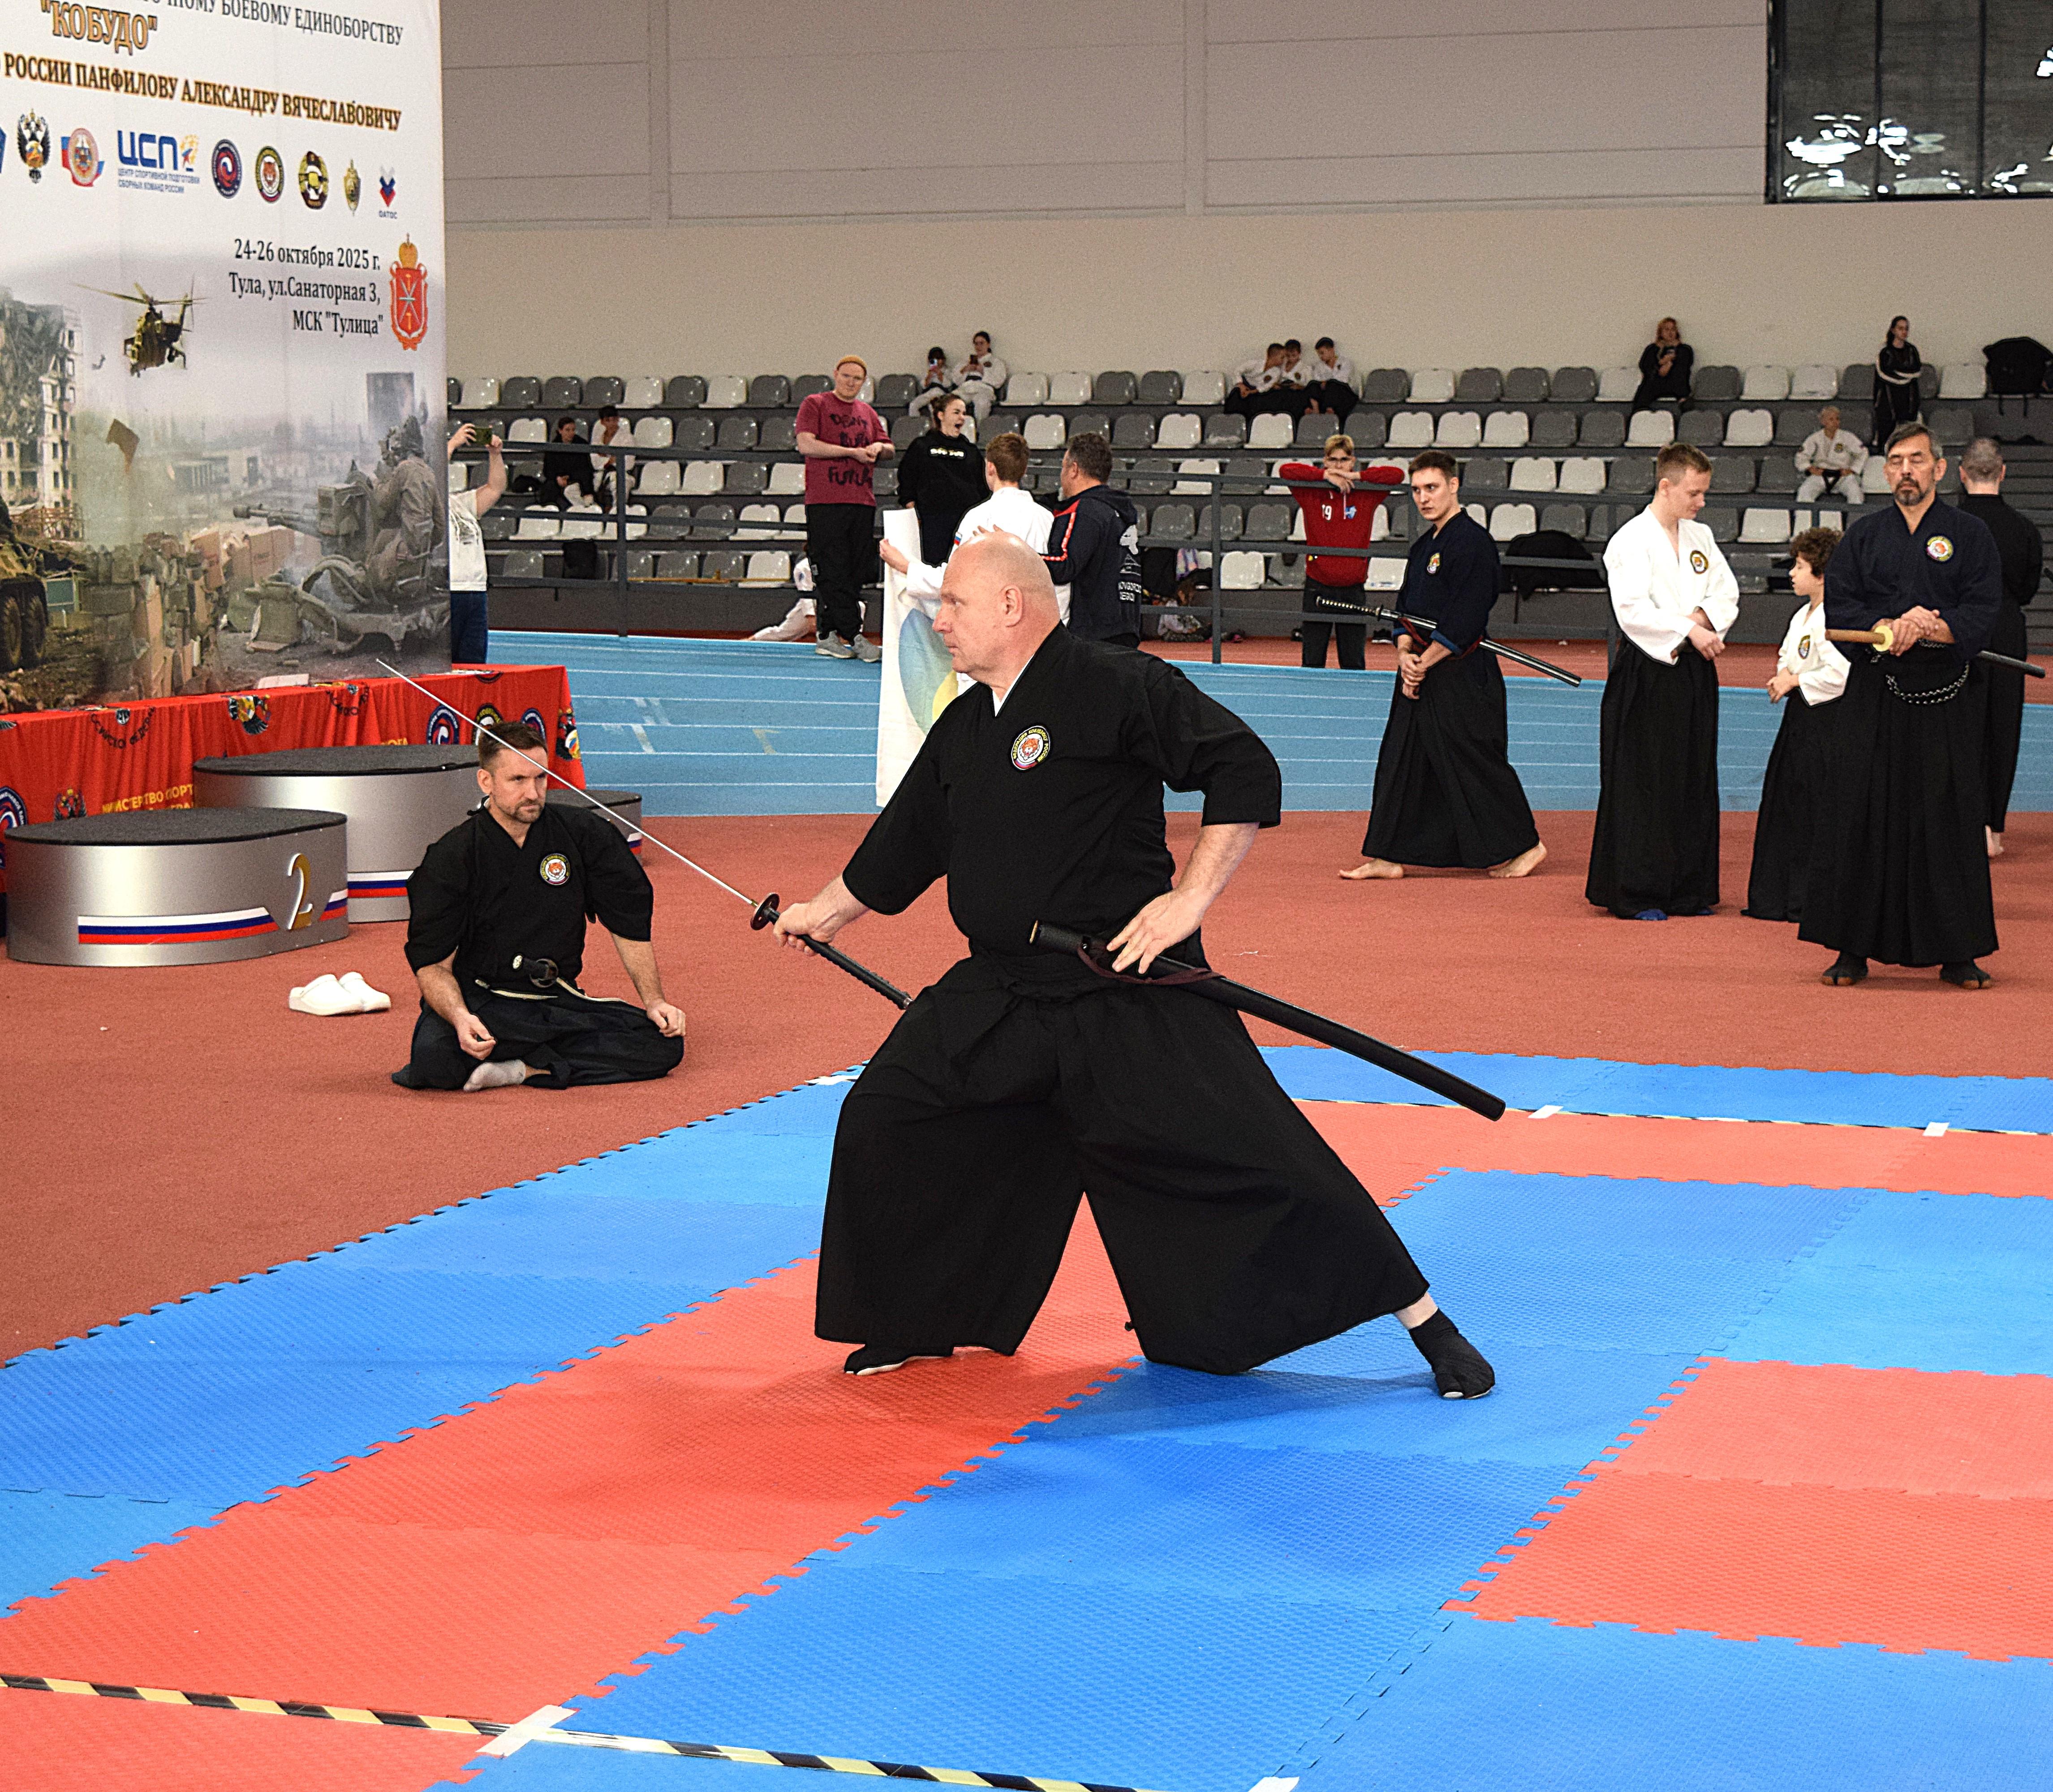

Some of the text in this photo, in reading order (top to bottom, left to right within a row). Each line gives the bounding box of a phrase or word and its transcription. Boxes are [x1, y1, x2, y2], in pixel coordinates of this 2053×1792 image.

[41, 0, 158, 56] "КОБУДО"
[295, 8, 403, 45] ЕДИНОБОРСТВУ
[4, 52, 402, 131] РОССИИ ПАНФИЛОВУ АЛЕКСАНДРУ ВЯЧЕСЛАВОВИЧУ
[117, 130, 178, 171] ЦСП
[235, 238, 380, 270] 24-26 октября 2025 г.
[229, 272, 381, 305] Тула, ул.Санаторная 3,
[293, 310, 383, 338] МСК "Тулица"
[1037, 743, 1049, 762] РОССИИ
[288, 853, 313, 930] 2
